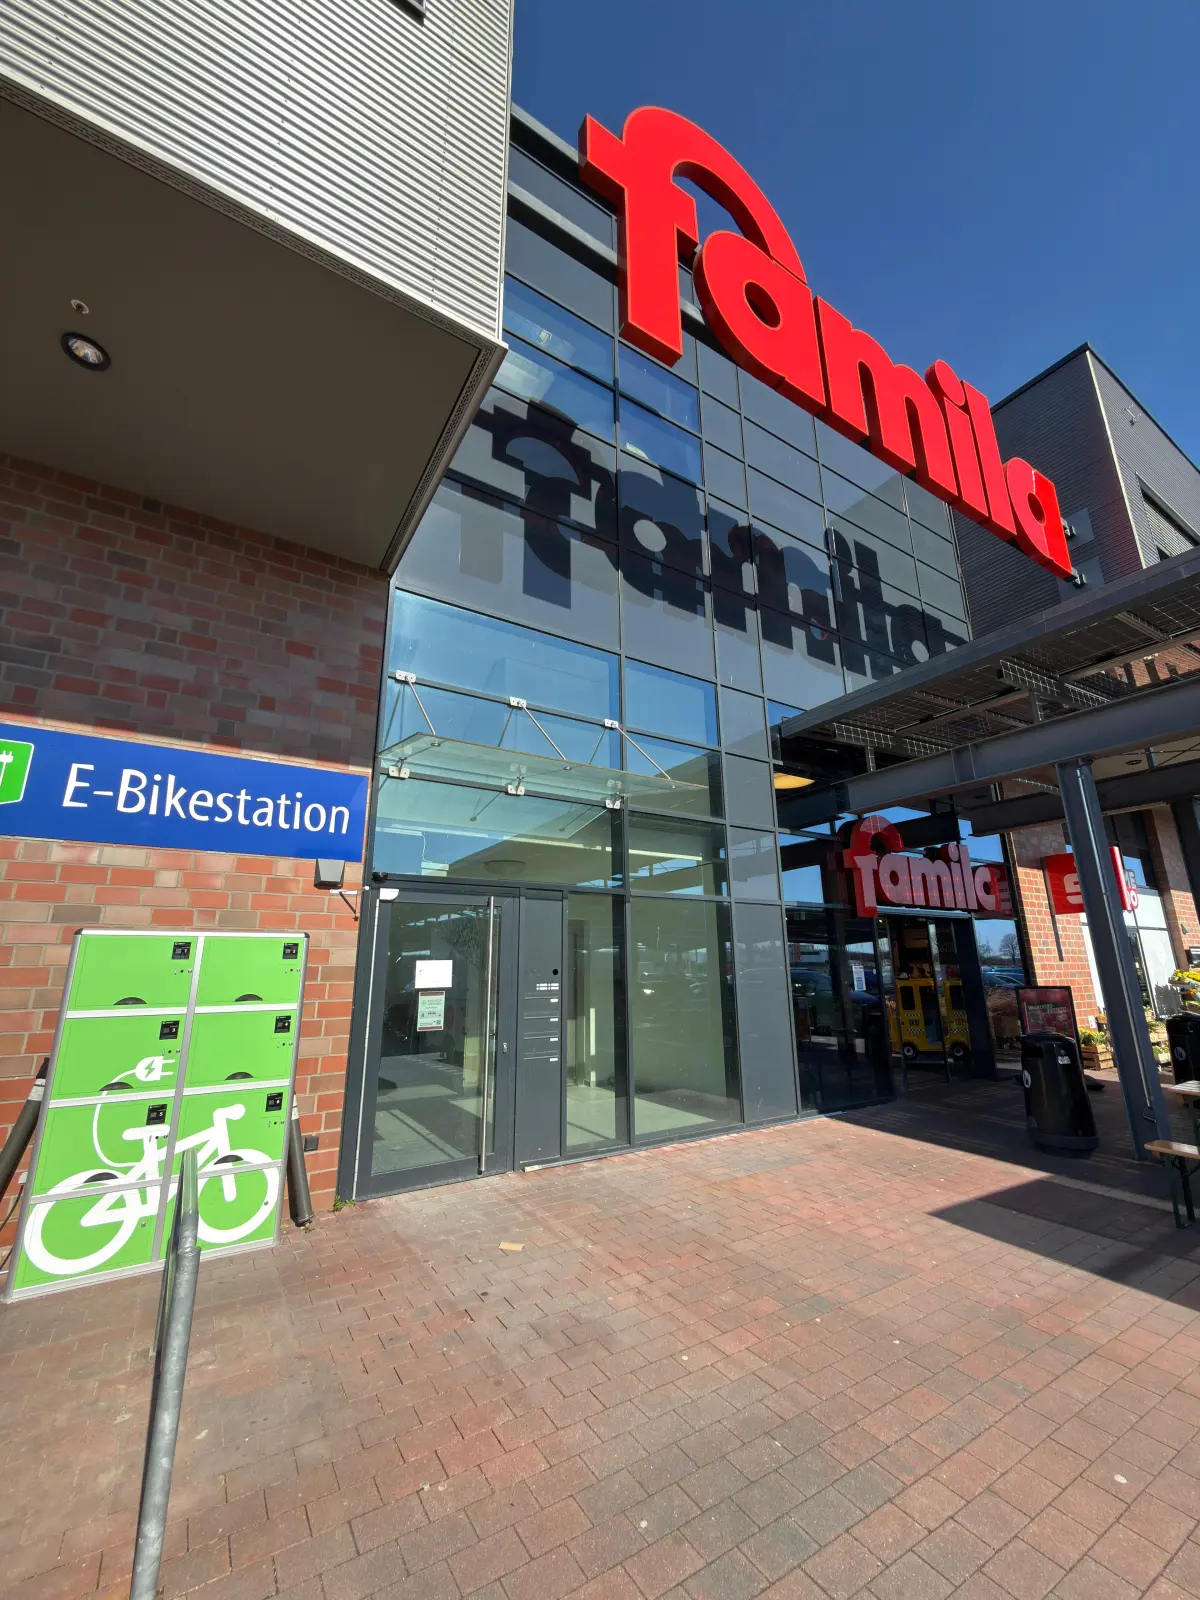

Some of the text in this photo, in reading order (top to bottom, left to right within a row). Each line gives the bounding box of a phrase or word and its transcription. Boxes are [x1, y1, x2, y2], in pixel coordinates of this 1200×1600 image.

[578, 105, 1073, 579] famila
[62, 762, 351, 835] E-Bikestation
[843, 814, 1002, 918] famila
